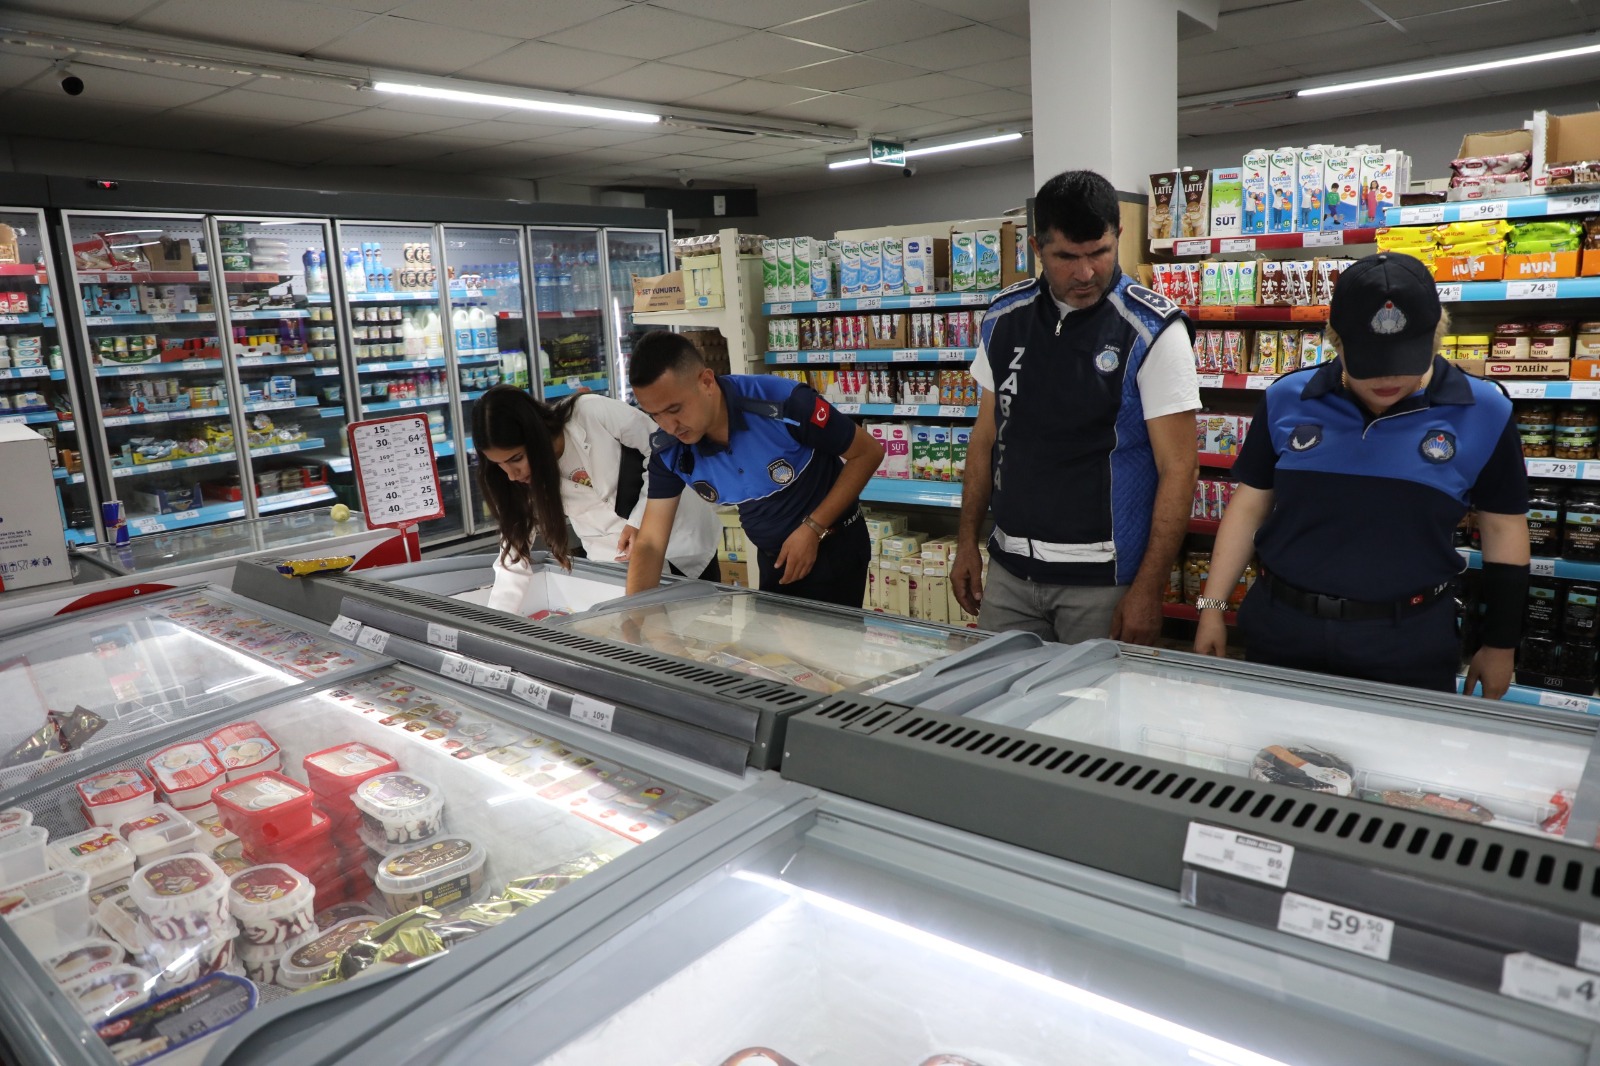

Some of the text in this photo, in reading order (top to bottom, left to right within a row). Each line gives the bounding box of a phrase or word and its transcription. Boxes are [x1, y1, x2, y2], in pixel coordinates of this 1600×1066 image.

[1154, 185, 1173, 195] LATTE
[1184, 183, 1203, 193] LATTE
[1215, 215, 1236, 226] SÜT
[1519, 260, 1557, 274] HUN
[652, 286, 681, 295] YUMURTA
[1515, 363, 1549, 373] TAHİN
[374, 425, 386, 434] 15
[375, 438, 388, 447] 30
[408, 434, 420, 442] 64
[413, 446, 425, 455] 15
[891, 441, 905, 451] SÜT
[421, 485, 433, 494] 25
[385, 491, 398, 500] 40
[423, 498, 434, 507] 32
[388, 504, 400, 513] 40
[1530, 521, 1542, 529] ZEO
[371, 634, 382, 644] 40
[456, 661, 468, 674] 30
[592, 710, 605, 721] 109
[1267, 857, 1283, 870] 89
